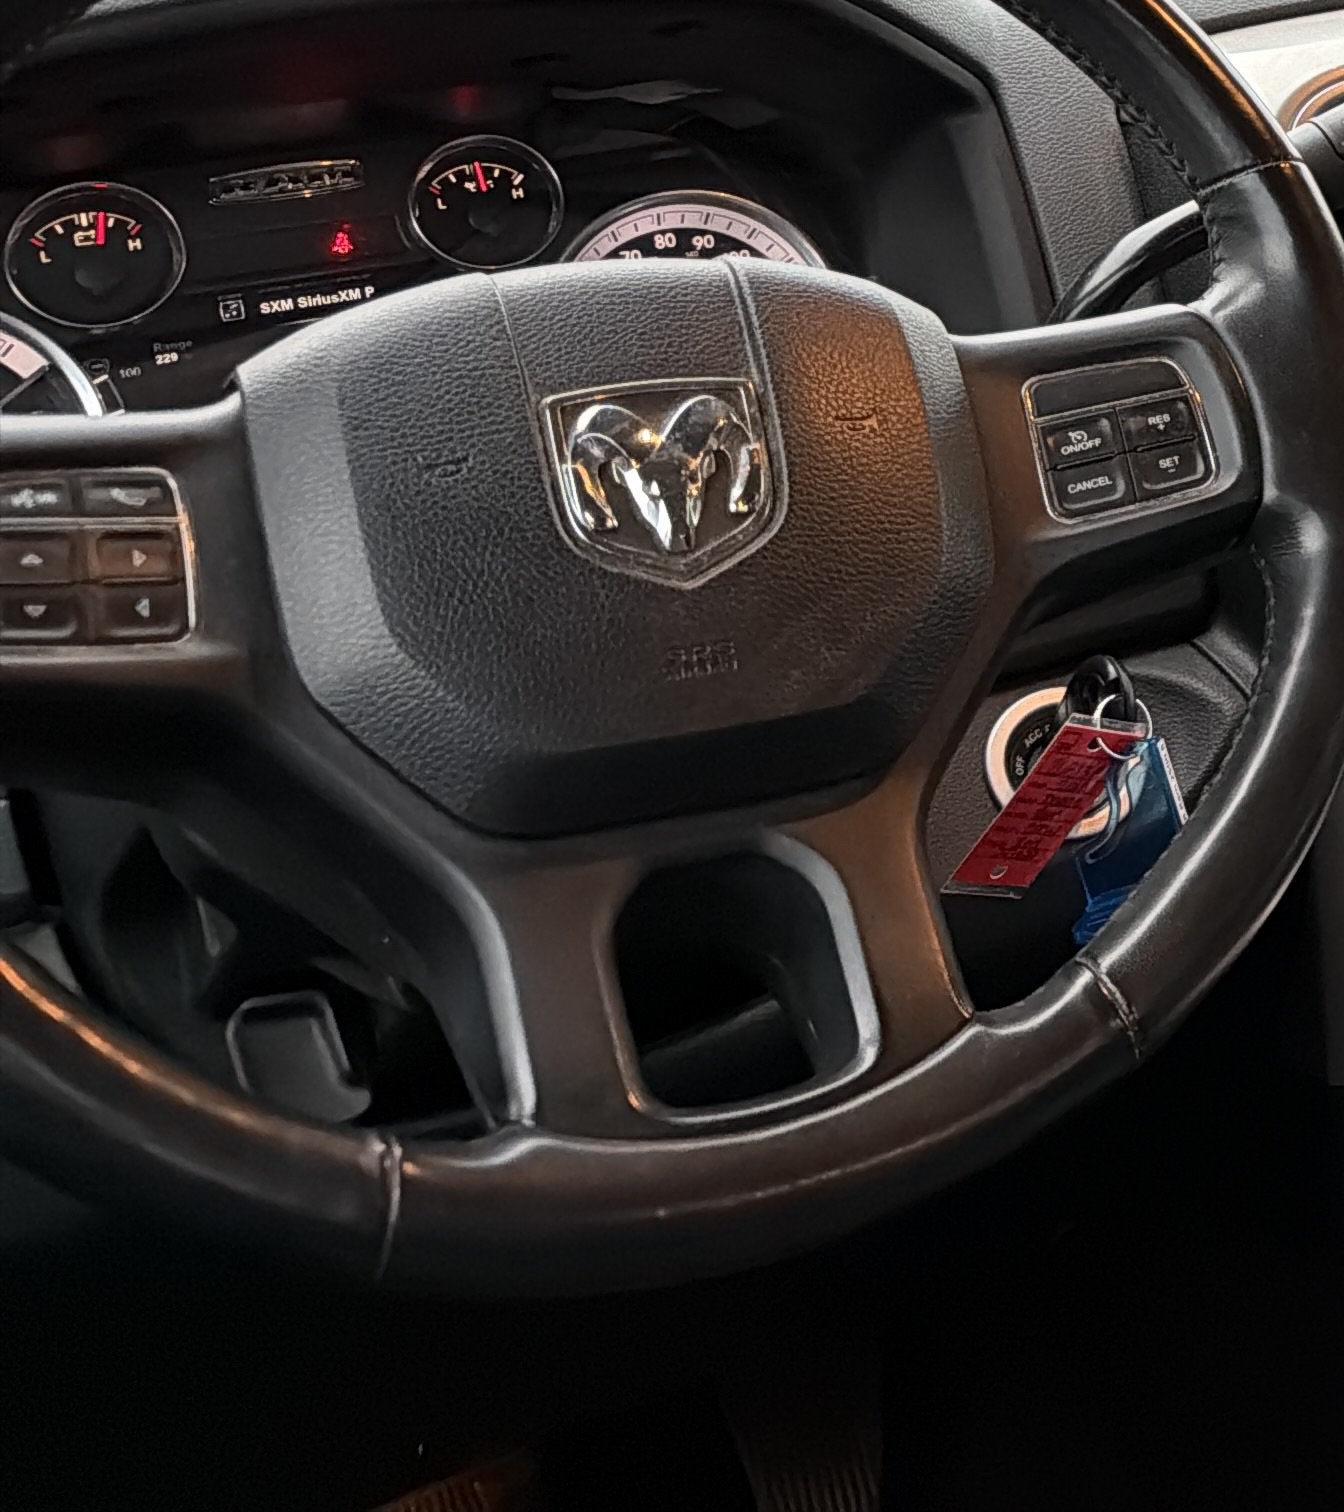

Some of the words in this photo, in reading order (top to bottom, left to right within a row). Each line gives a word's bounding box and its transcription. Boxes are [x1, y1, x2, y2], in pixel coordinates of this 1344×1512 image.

[512, 187, 524, 199] H
[436, 197, 447, 209] L
[128, 238, 142, 251] H
[653, 232, 677, 249] 80
[692, 234, 715, 250] 90
[39, 251, 52, 263] L
[259, 299, 294, 315] SXM
[297, 288, 361, 308] SiriusXM
[1148, 413, 1171, 426] RES
[1060, 437, 1102, 456] ON/OFF
[1158, 455, 1180, 469] SET
[1067, 475, 1113, 495] CANCEL
[1024, 727, 1043, 747] ACC
[1015, 756, 1025, 776] OFF
